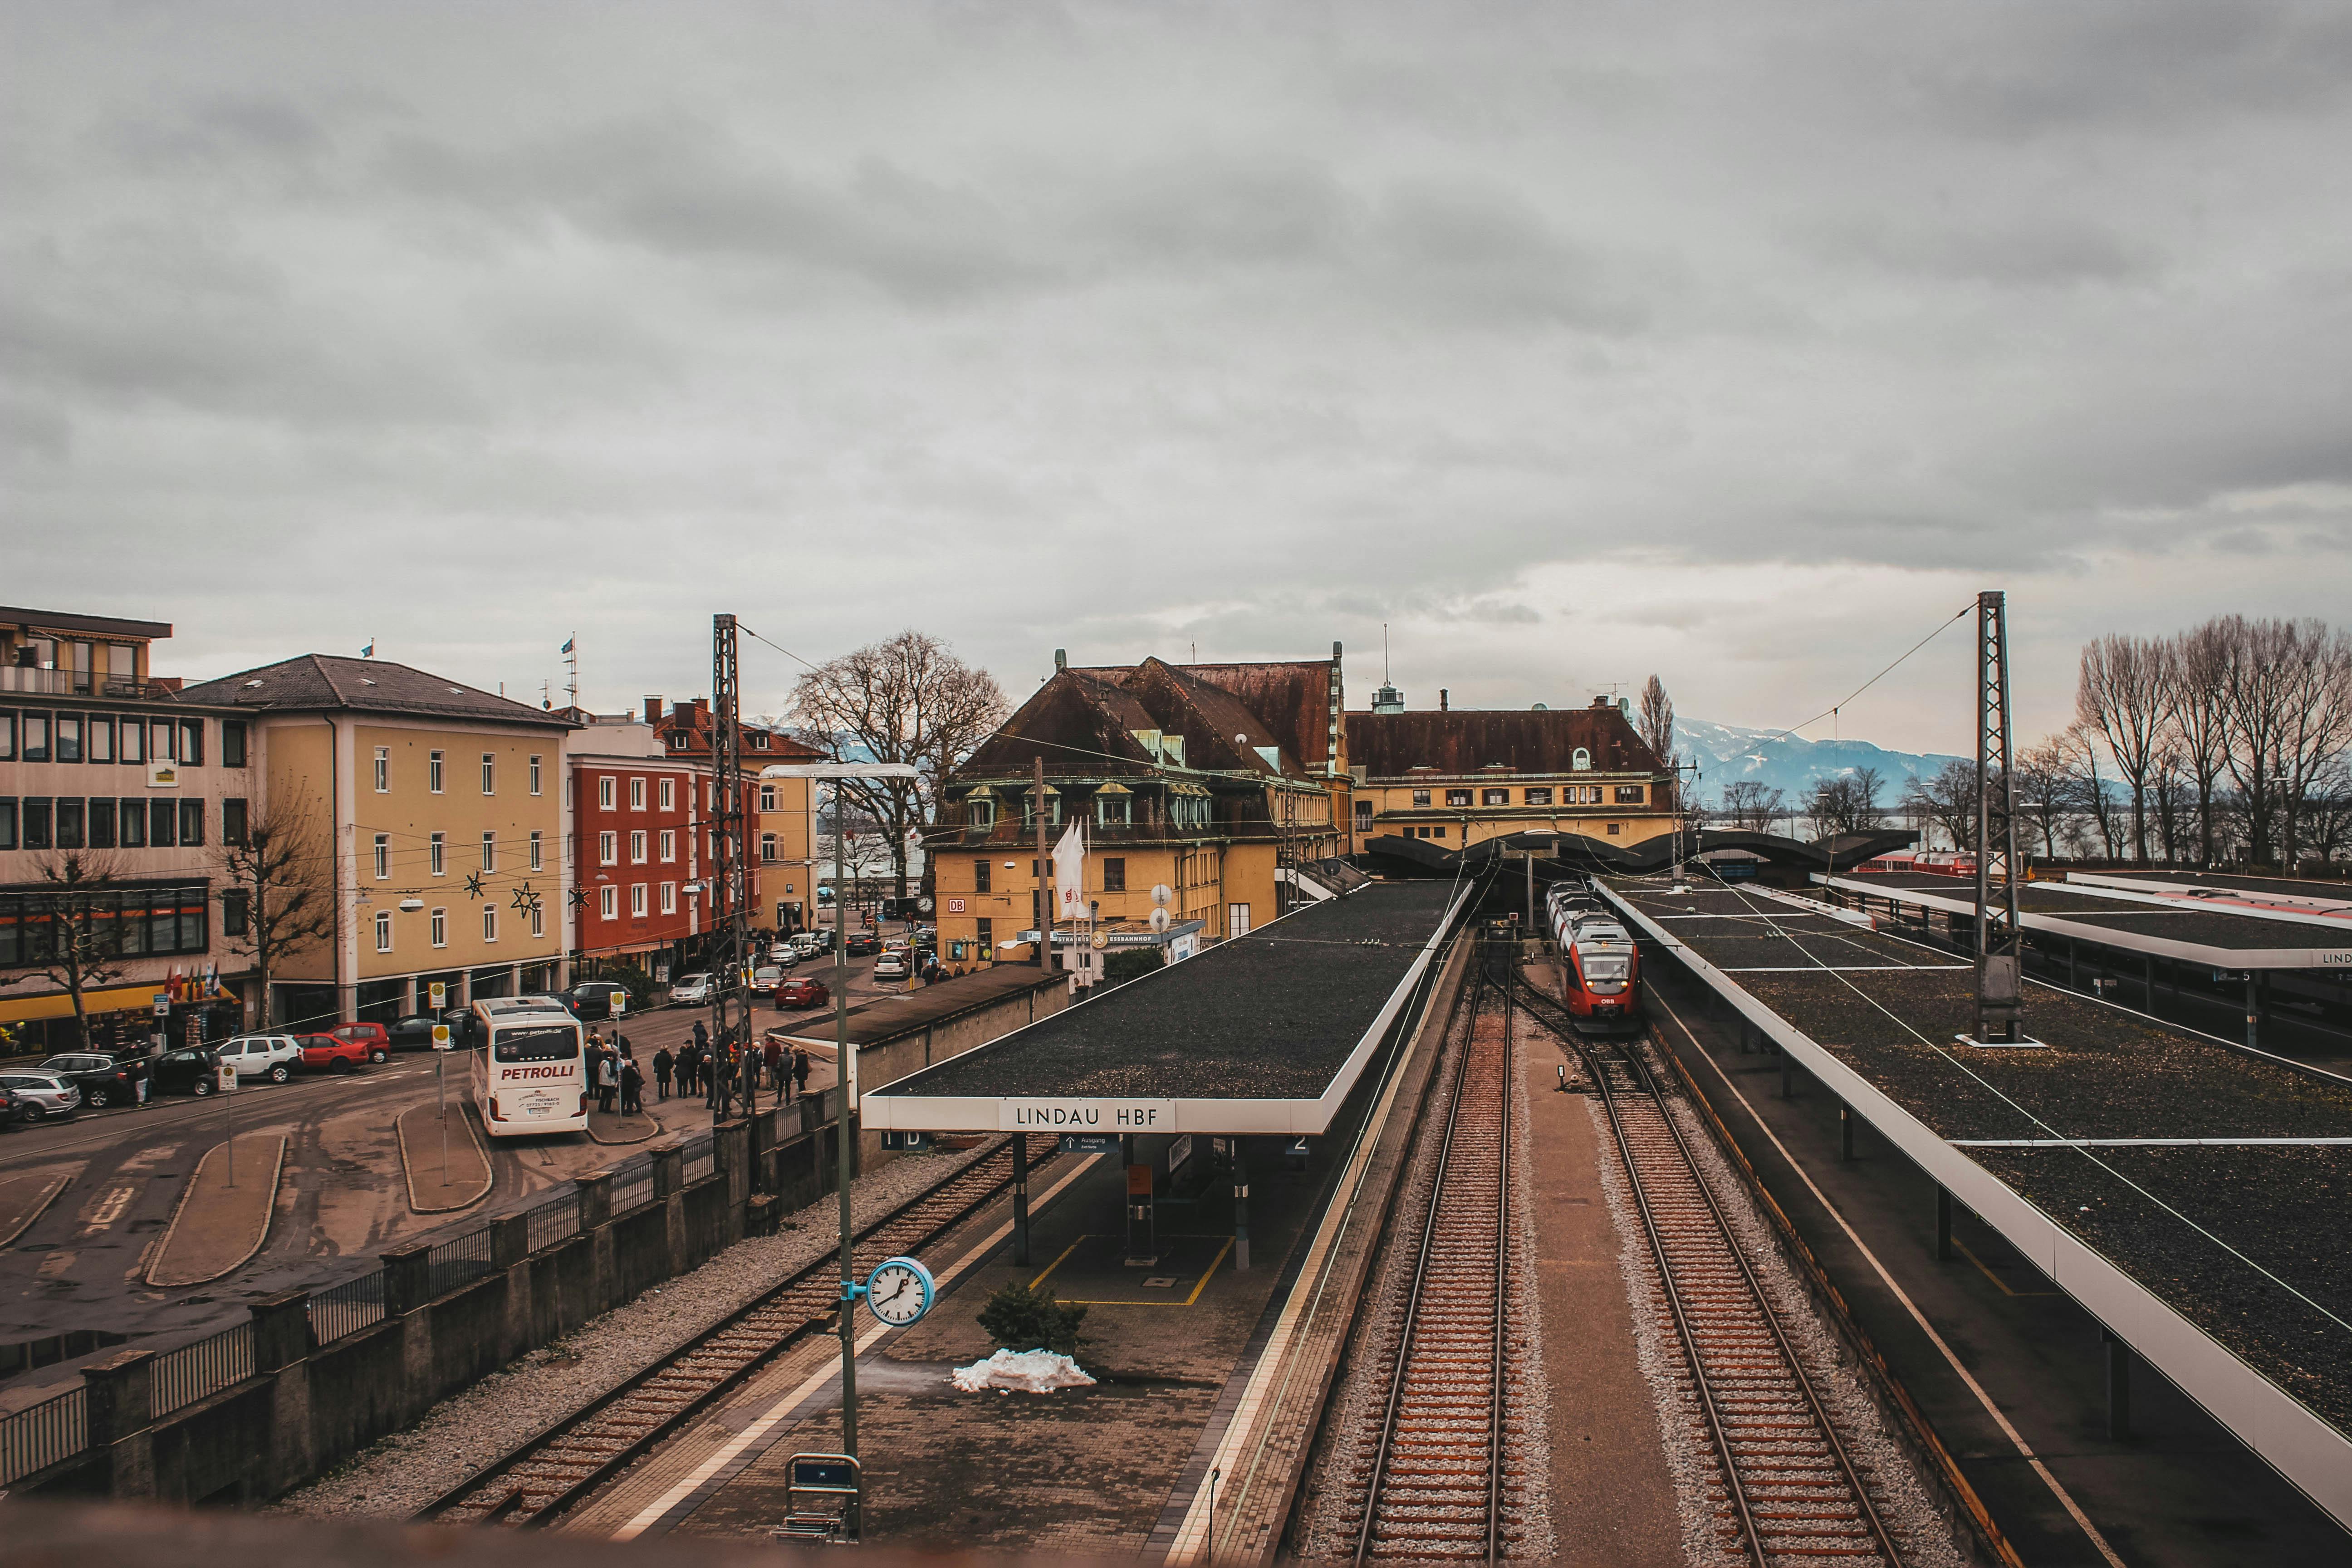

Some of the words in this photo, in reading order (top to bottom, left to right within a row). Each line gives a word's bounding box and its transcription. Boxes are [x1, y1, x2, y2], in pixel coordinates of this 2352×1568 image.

[951, 901, 963, 910] DB
[2243, 971, 2250, 981] 5
[501, 1065, 574, 1080] PETROLLI
[1017, 1108, 1098, 1125] LINDAU
[1117, 1108, 1157, 1126] HBF
[907, 1132, 920, 1146] D
[1294, 1135, 1306, 1150] 2
